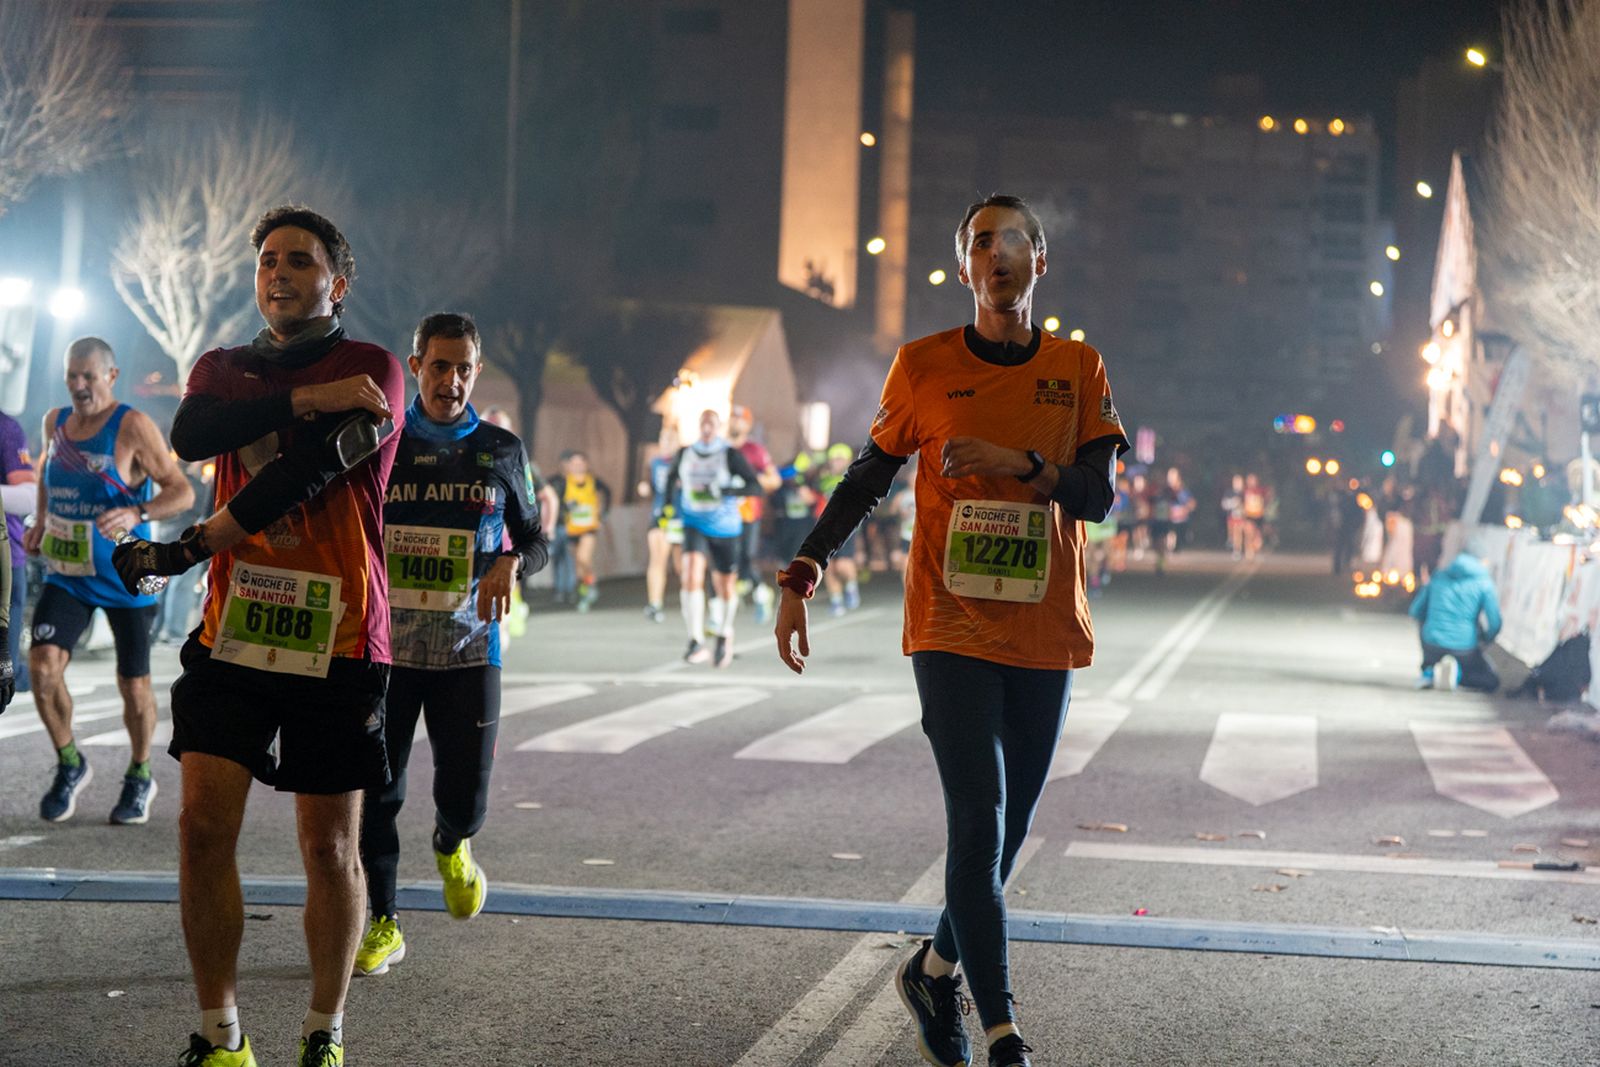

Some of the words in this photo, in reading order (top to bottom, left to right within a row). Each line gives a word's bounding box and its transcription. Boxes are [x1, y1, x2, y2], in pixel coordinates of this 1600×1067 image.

[946, 388, 976, 400] vive
[424, 480, 496, 505] ANTÓN
[973, 510, 1006, 522] NOCHE
[1007, 514, 1021, 524] DE
[960, 521, 982, 532] SAN
[983, 522, 1020, 536] ANTÓN
[403, 535, 428, 544] NOCHE
[430, 538, 440, 546] DE
[393, 545, 410, 554] SAN
[411, 545, 440, 556] ANTÓN
[962, 534, 1038, 568] 12278
[400, 556, 454, 583] 1406
[250, 577, 282, 590] NOCHE
[283, 580, 298, 592] DE
[239, 586, 260, 600] SAN
[260, 591, 296, 606] ANTÓN
[246, 601, 314, 640] 6188
